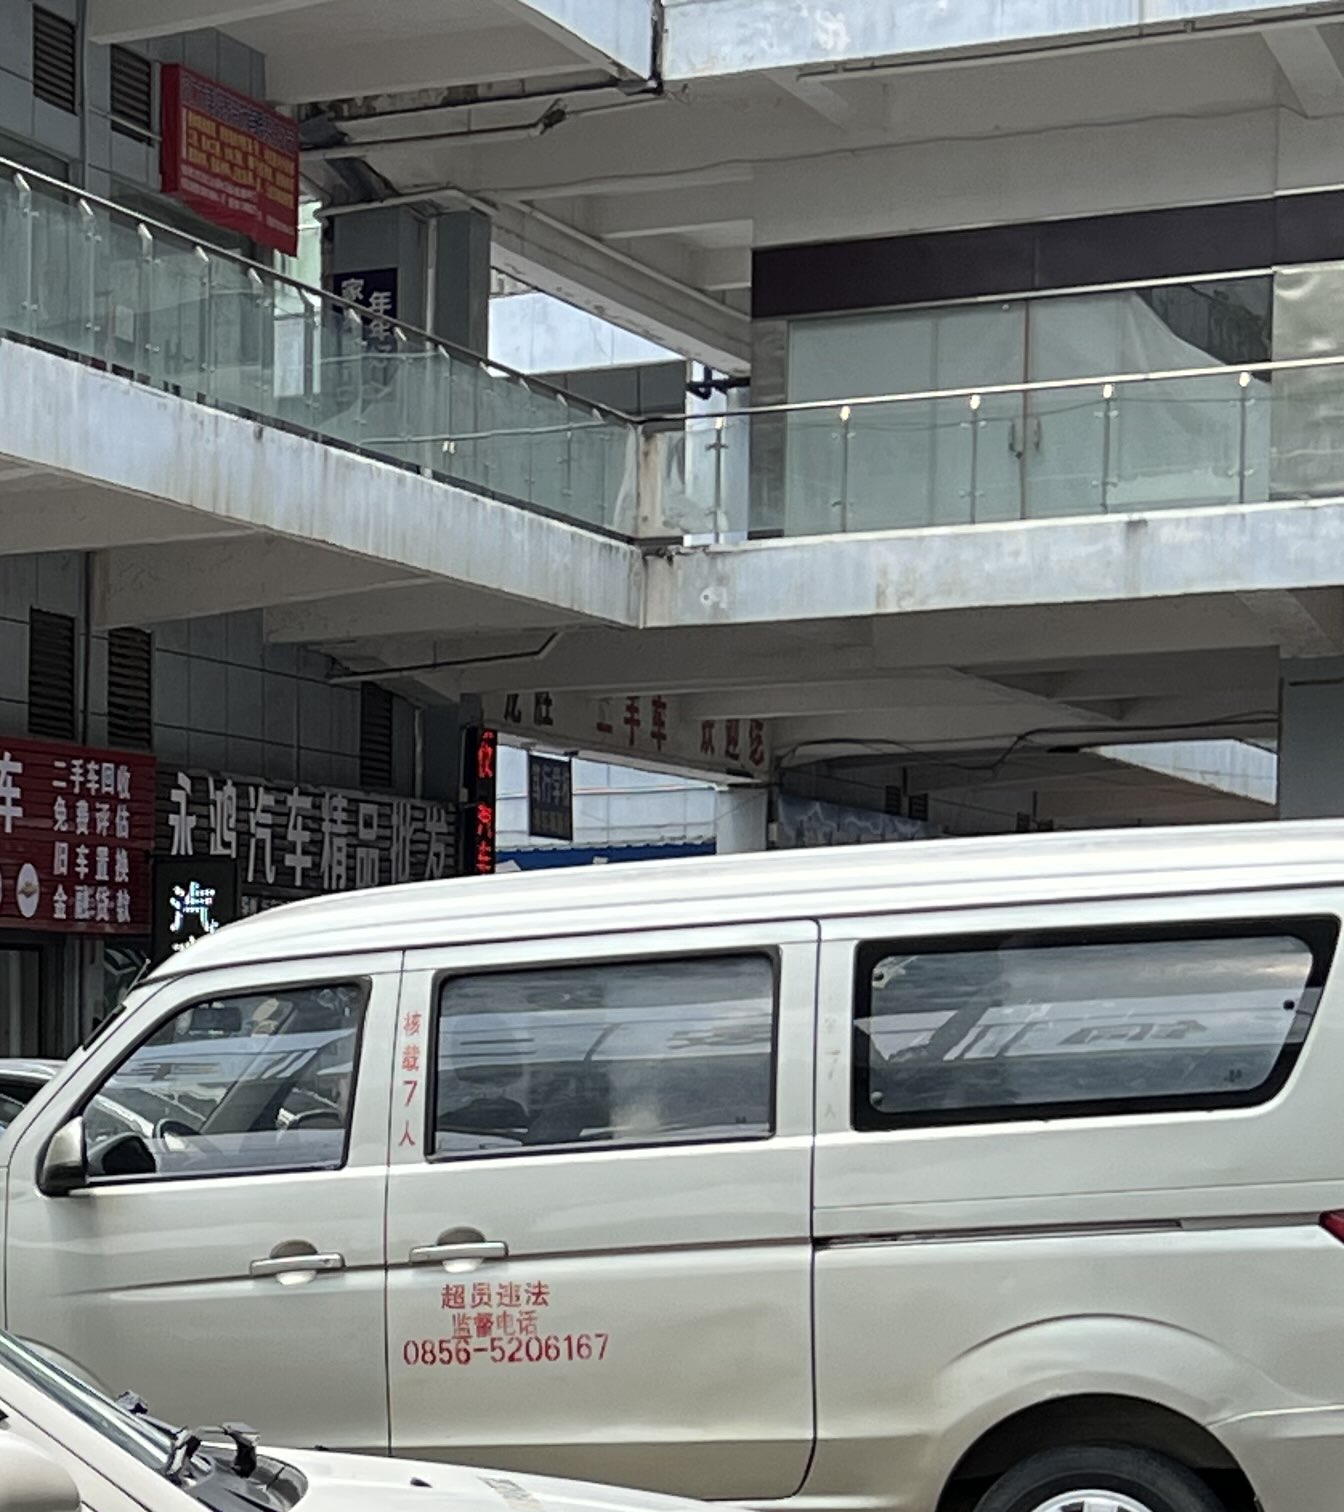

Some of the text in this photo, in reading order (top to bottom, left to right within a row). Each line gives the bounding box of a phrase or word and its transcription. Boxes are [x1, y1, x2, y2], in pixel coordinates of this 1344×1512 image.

[52, 758, 131, 800] 二手车回收
[53, 794, 131, 840] 免费评估
[168, 771, 450, 890] 永鸿汽车精品批发
[53, 841, 130, 883] 旧车置换
[53, 882, 132, 923] 金融贷款
[398, 1011, 423, 1147] 核载7人
[441, 1281, 551, 1310] 超员违法
[451, 1310, 539, 1340] 监督电话
[403, 1333, 610, 1366] 0856-5206167
